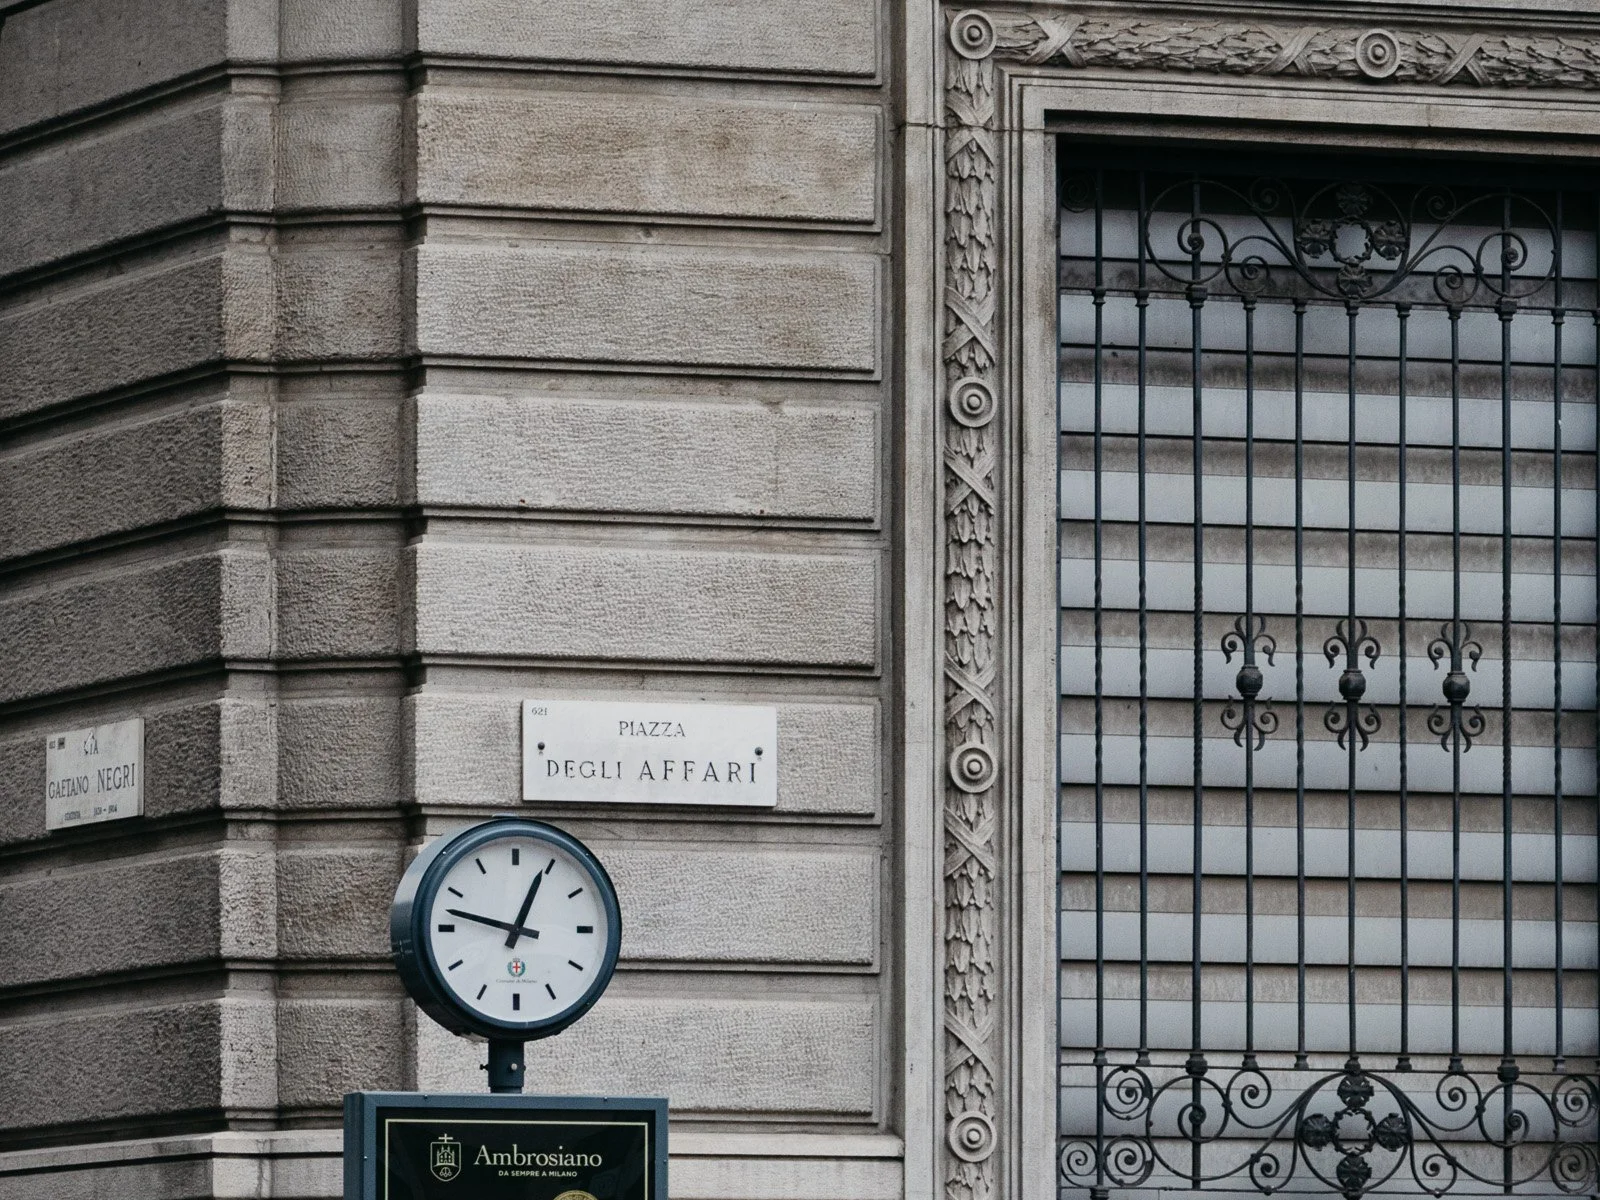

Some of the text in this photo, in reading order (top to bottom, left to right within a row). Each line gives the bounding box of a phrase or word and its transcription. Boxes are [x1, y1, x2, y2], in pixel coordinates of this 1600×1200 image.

[531, 707, 548, 716] 621
[619, 721, 686, 737] PIAZZA
[48, 763, 136, 800] GAETANO NEGRI
[547, 759, 756, 784] DEGLI AFFARI
[473, 1143, 603, 1167] Ambrosiano
[548, 1170, 578, 1178] MILANO
